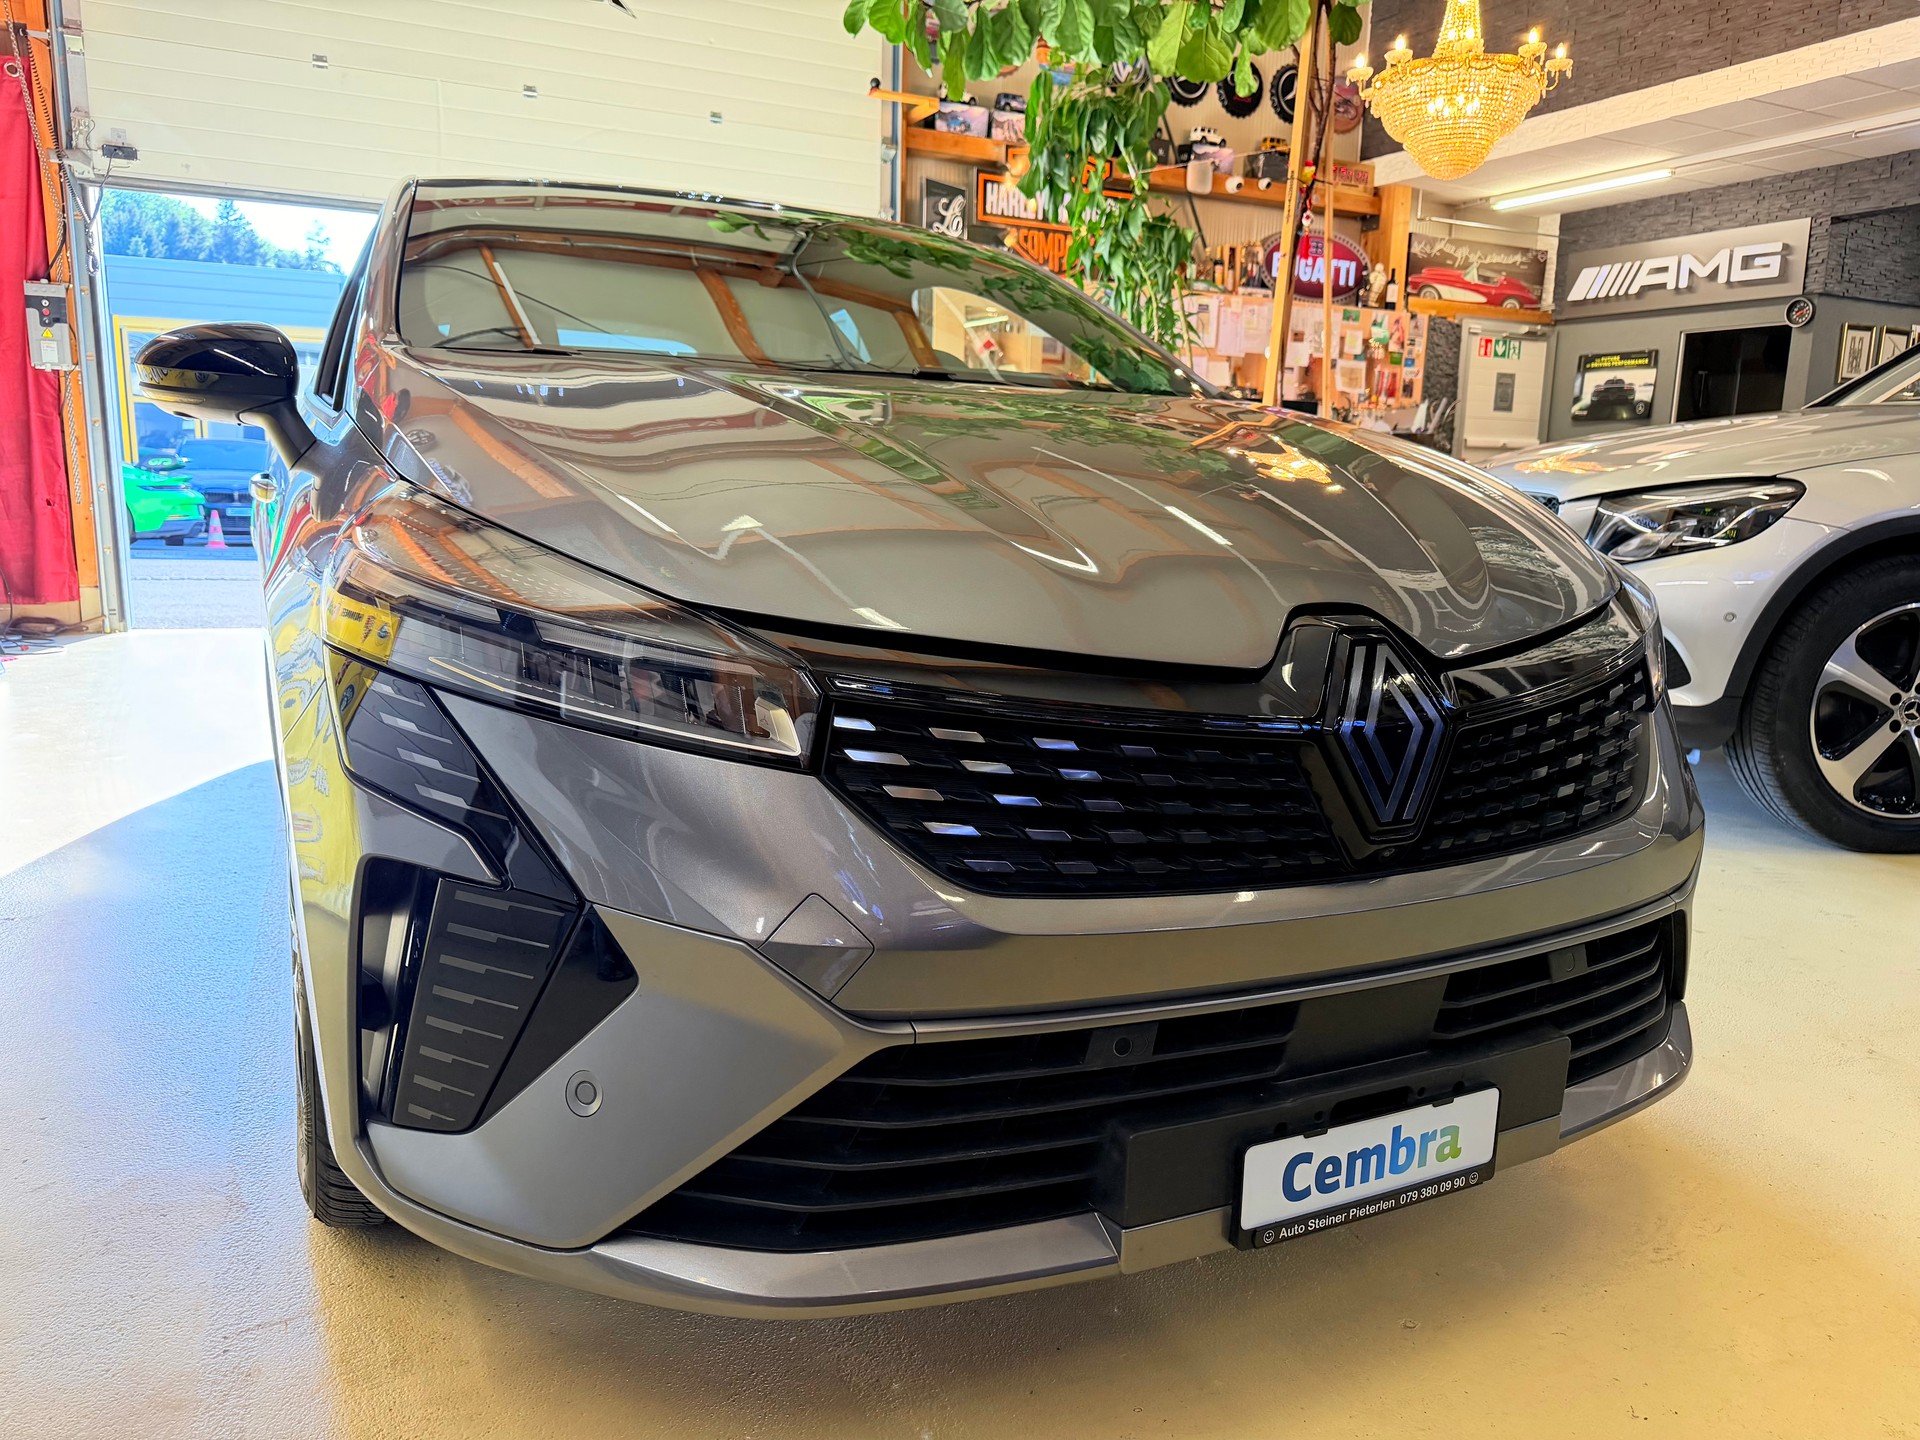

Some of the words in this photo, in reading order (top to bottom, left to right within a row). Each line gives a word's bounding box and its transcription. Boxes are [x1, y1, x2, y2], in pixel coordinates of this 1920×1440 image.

[1271, 250, 1357, 287] BGATTI
[1628, 242, 1784, 295] AMG
[1282, 1125, 1462, 1202] Cembra
[1279, 1223, 1305, 1239] Auto
[1308, 1211, 1347, 1232] Steiner
[1349, 1198, 1395, 1220] Pieterlen
[1400, 1192, 1418, 1205] 079
[1420, 1186, 1438, 1200] 380
[1439, 1180, 1452, 1194] 09
[1453, 1177, 1466, 1189] 90
